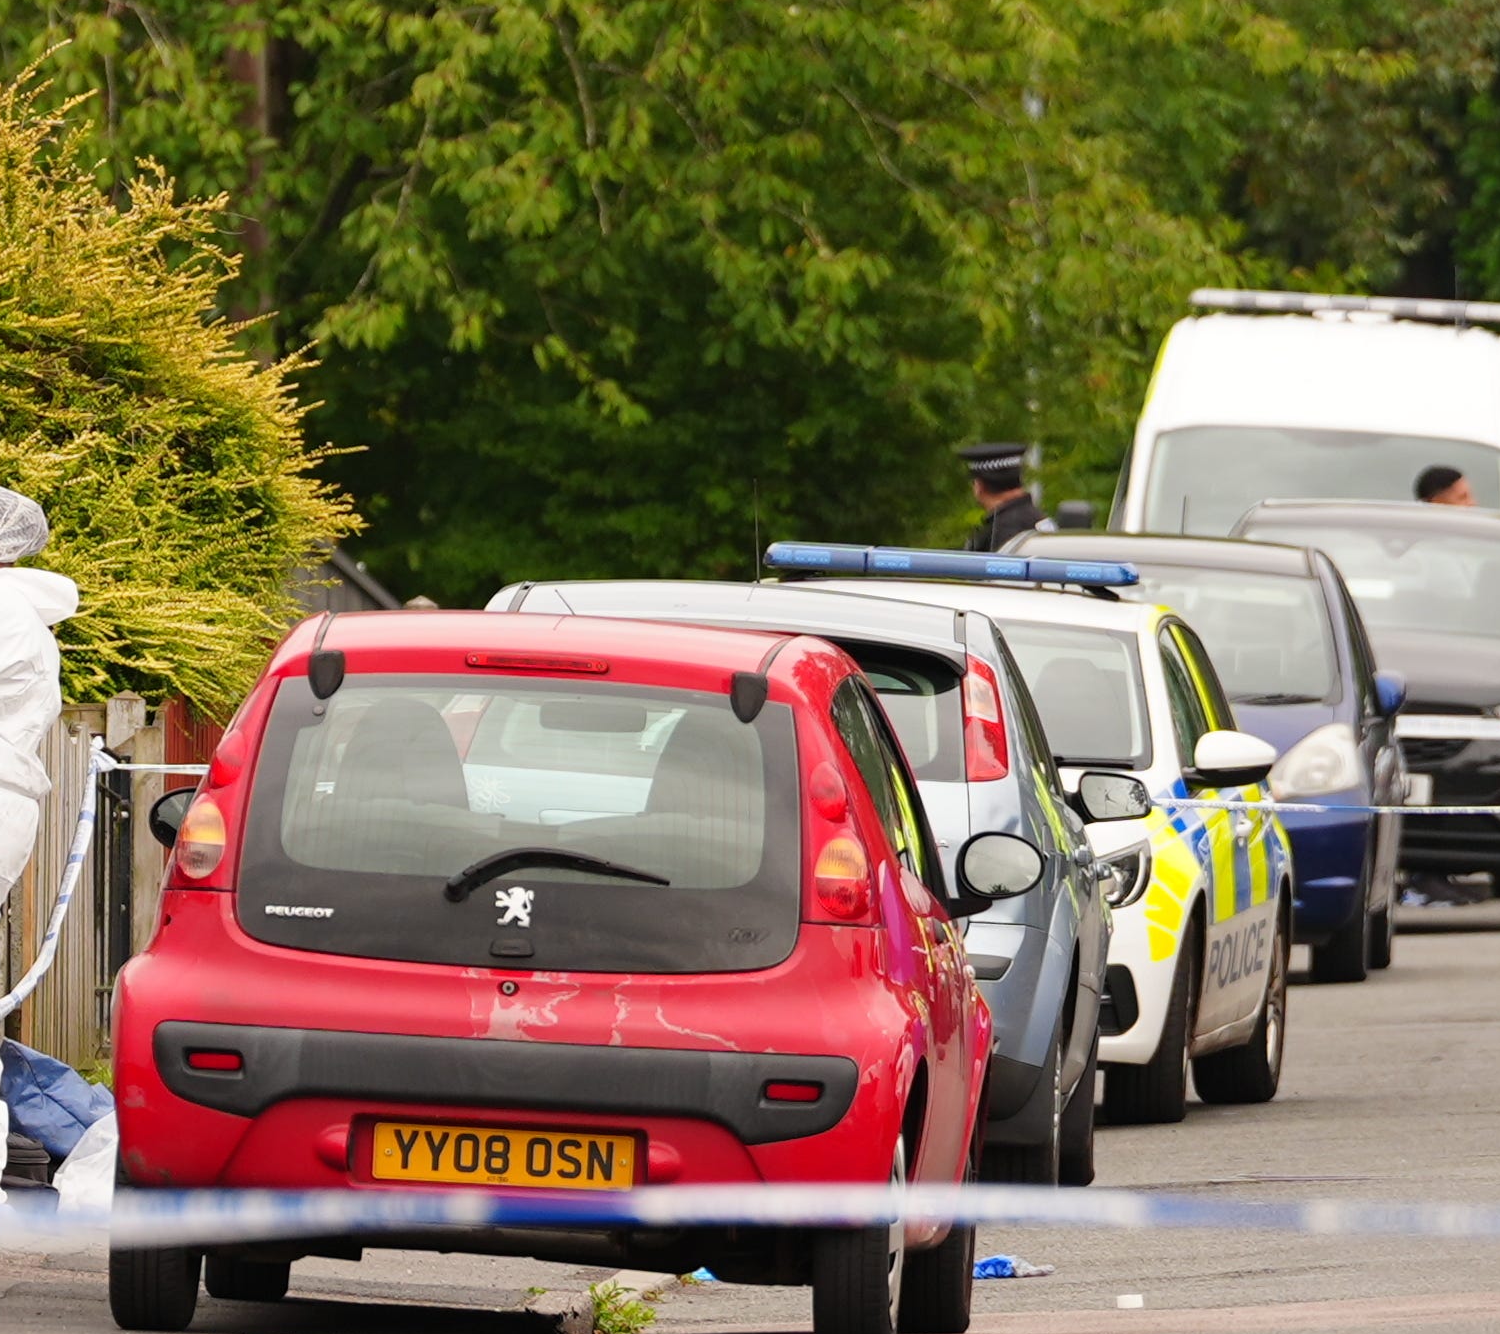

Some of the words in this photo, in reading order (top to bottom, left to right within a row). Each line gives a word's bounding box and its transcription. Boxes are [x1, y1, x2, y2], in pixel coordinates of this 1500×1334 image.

[264, 904, 335, 919] PEUGEOT
[1205, 918, 1267, 994] POLICE
[393, 1128, 510, 1175] YY08
[525, 1137, 615, 1181] OSN
